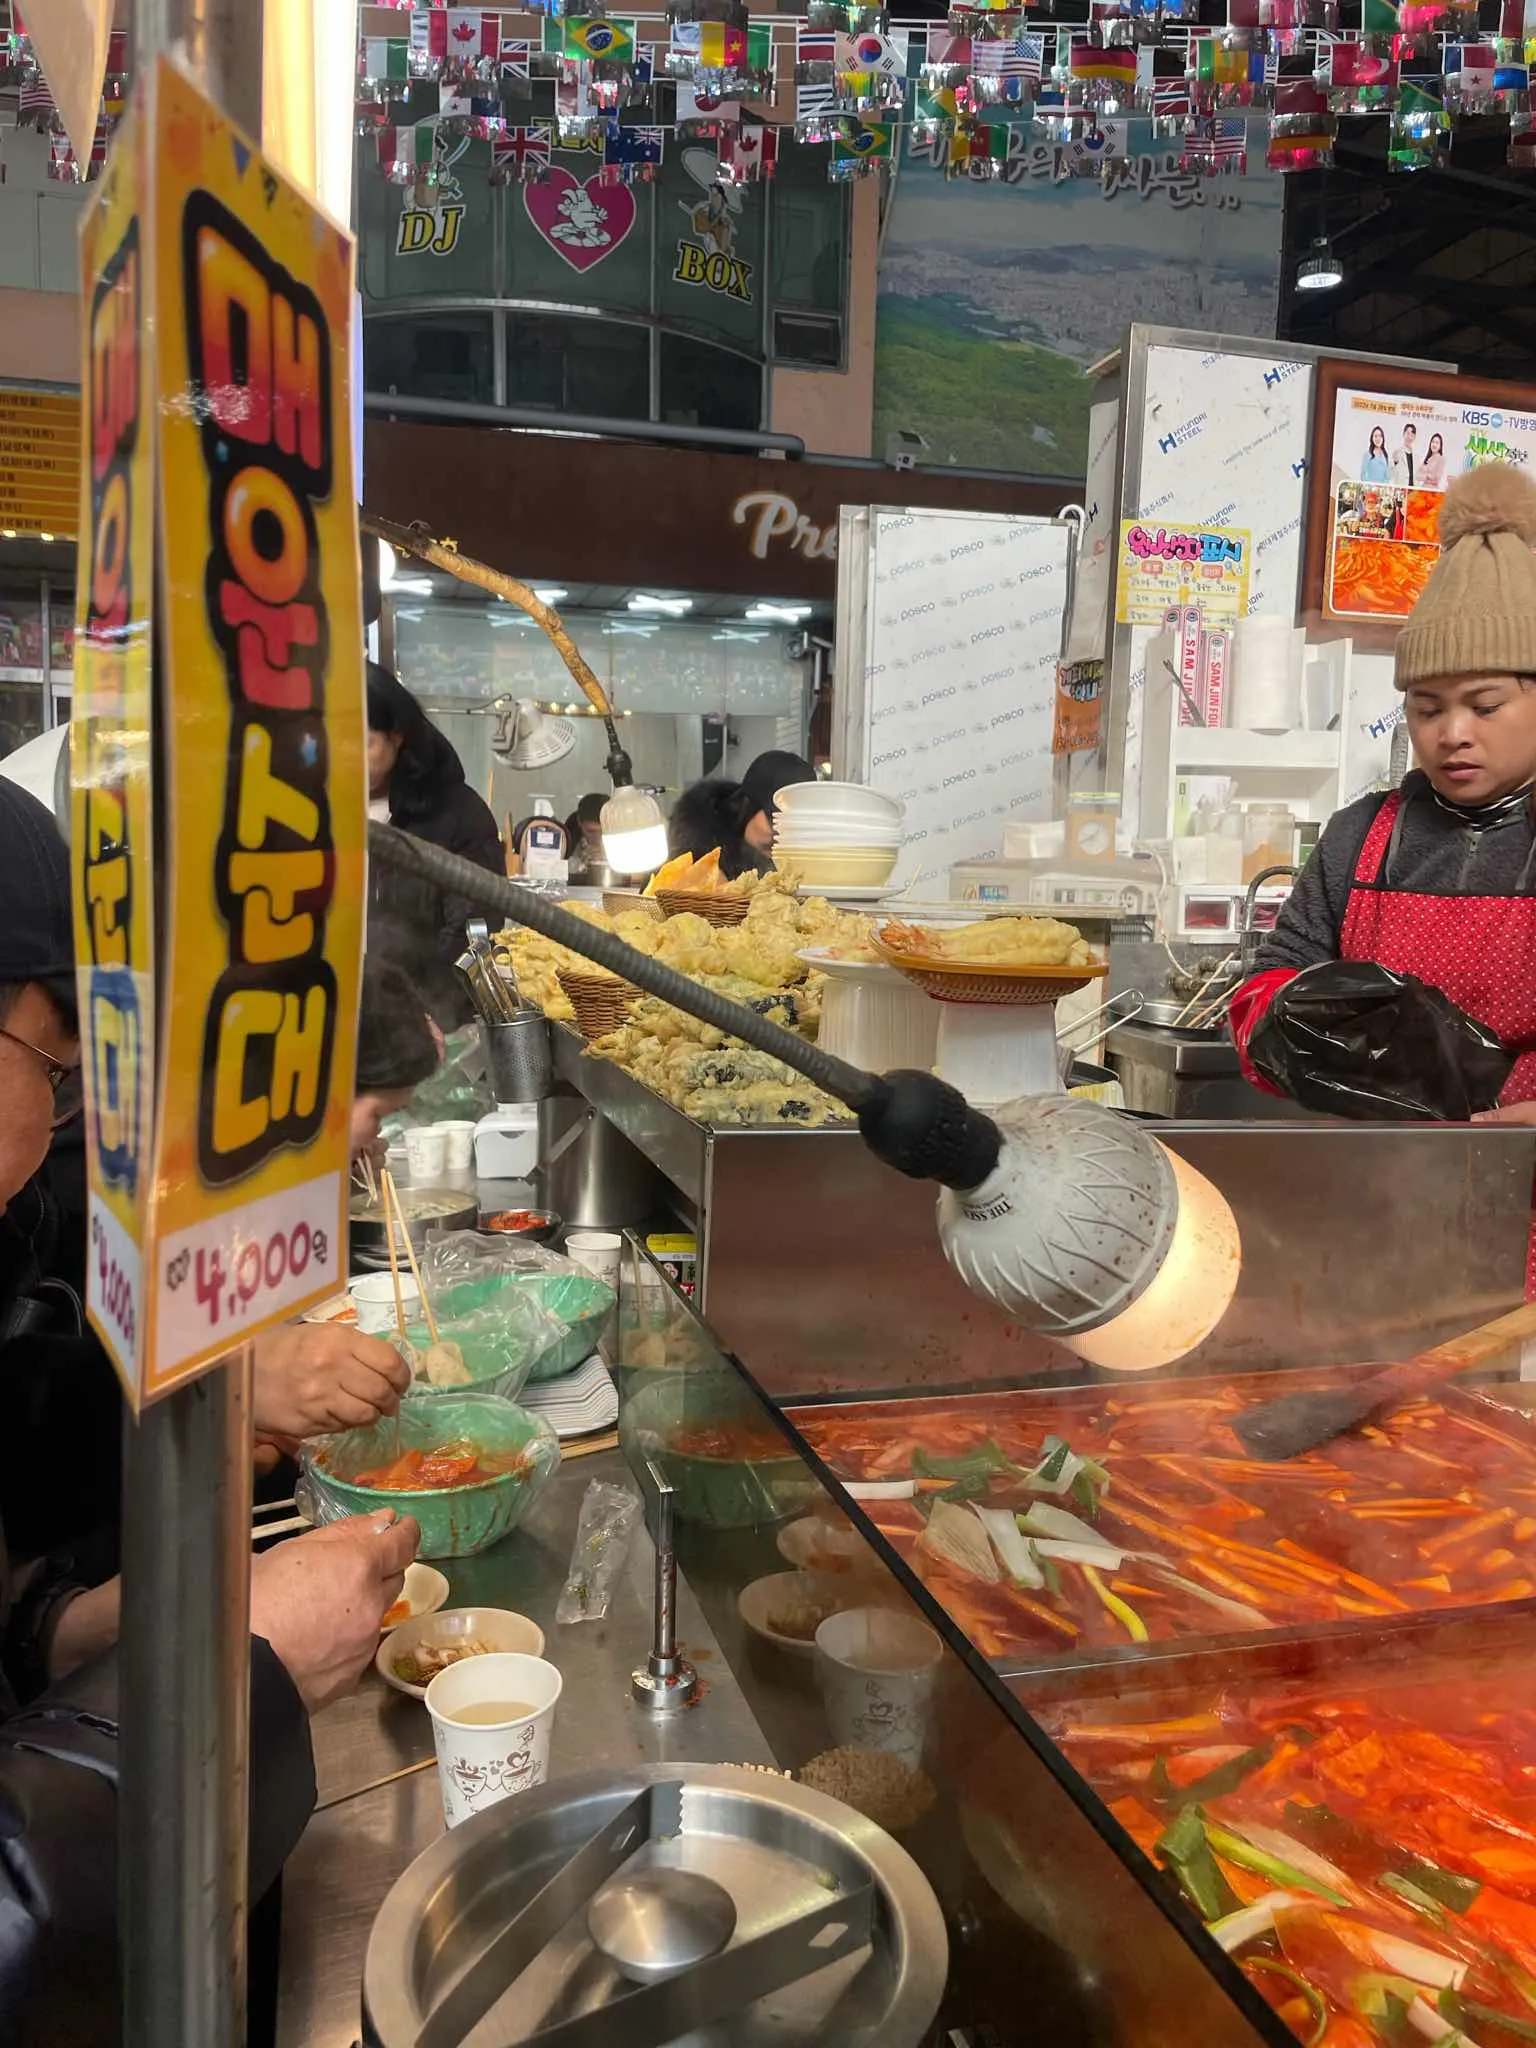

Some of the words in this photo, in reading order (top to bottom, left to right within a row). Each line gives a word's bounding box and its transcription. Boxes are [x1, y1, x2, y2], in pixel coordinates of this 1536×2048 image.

[398, 206, 464, 254] DJ
[675, 242, 752, 302] BOX
[1173, 410, 1208, 437] HYUNDAI
[1462, 410, 1490, 426] KBS
[1177, 426, 1203, 445] STEEL
